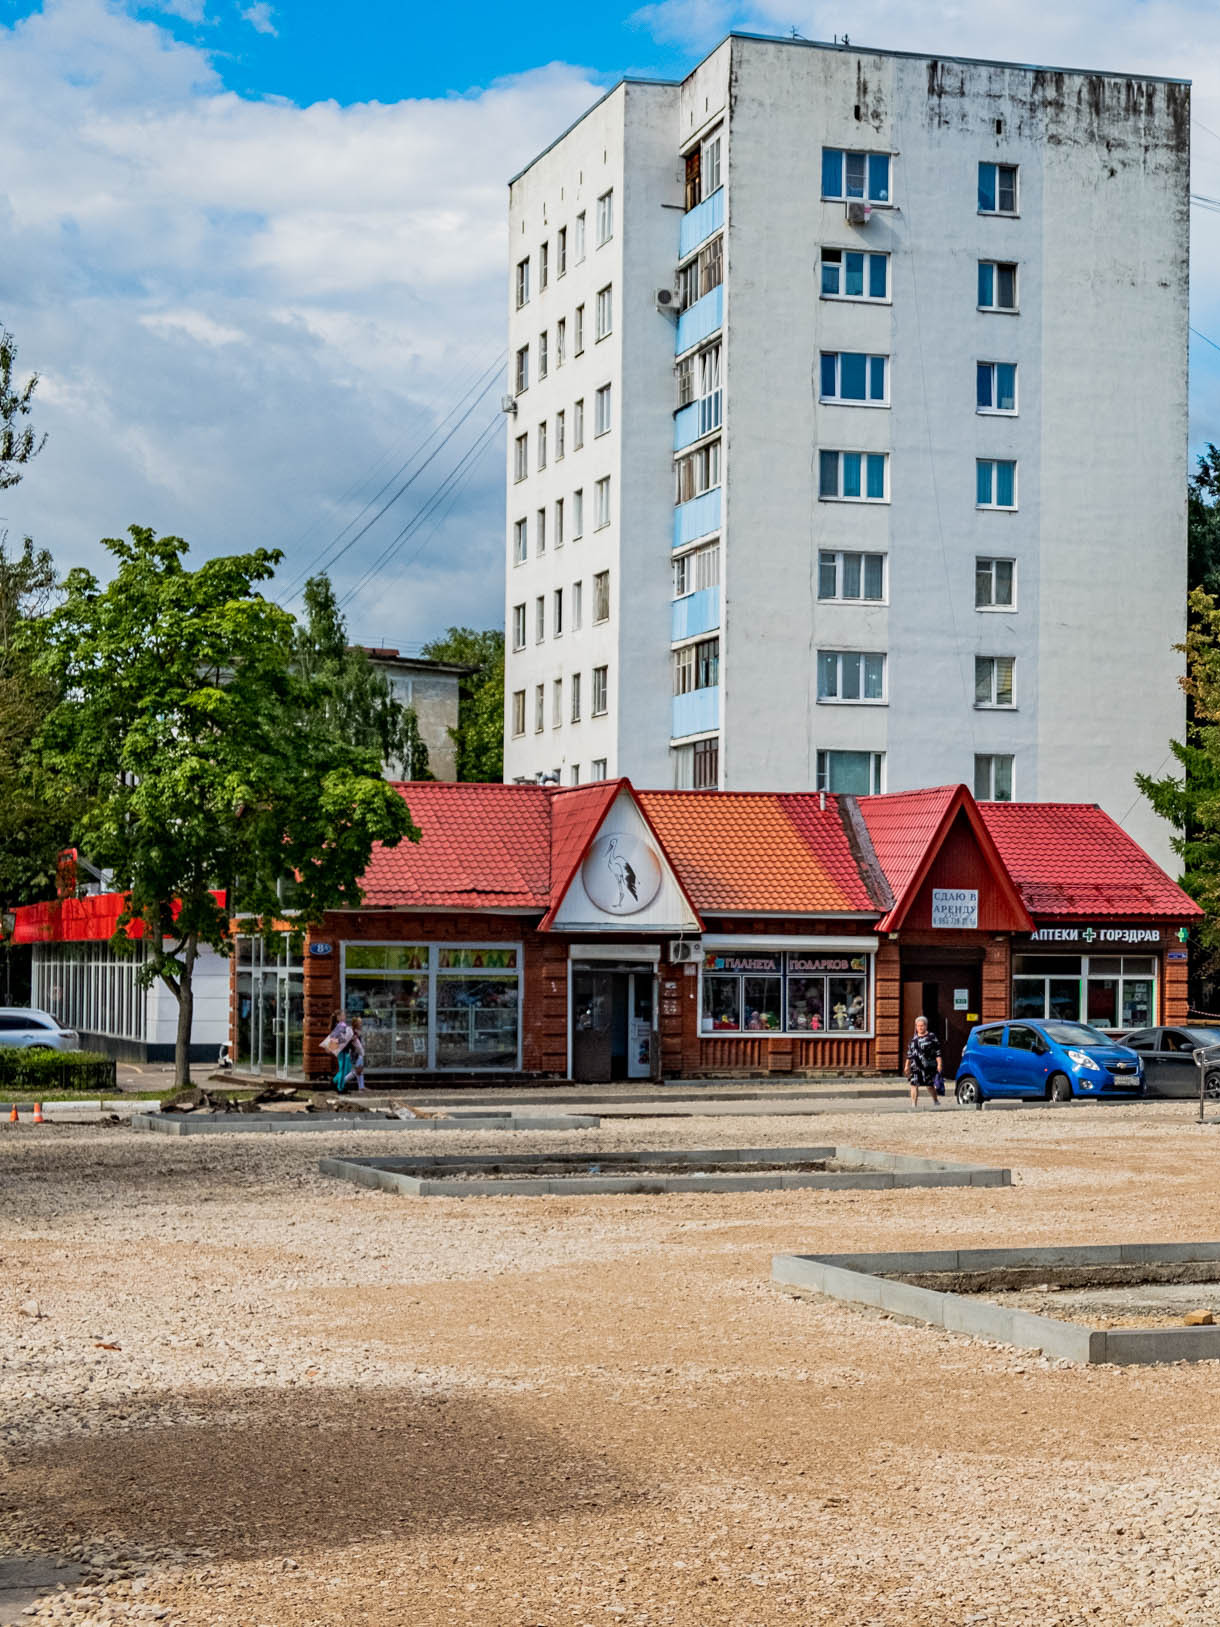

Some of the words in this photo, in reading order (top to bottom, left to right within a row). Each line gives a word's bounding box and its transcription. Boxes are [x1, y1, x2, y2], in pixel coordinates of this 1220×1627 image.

[934, 892, 966, 902] СДАЮ
[970, 893, 977, 901] В
[933, 905, 977, 915] АРЕНДУ
[1030, 929, 1079, 941] АПТЕКИ
[1100, 929, 1160, 943] ГОРЗДРАВ
[725, 958, 776, 970] ПЛАНЕТА
[789, 959, 849, 970] ПОДАРКОВ
